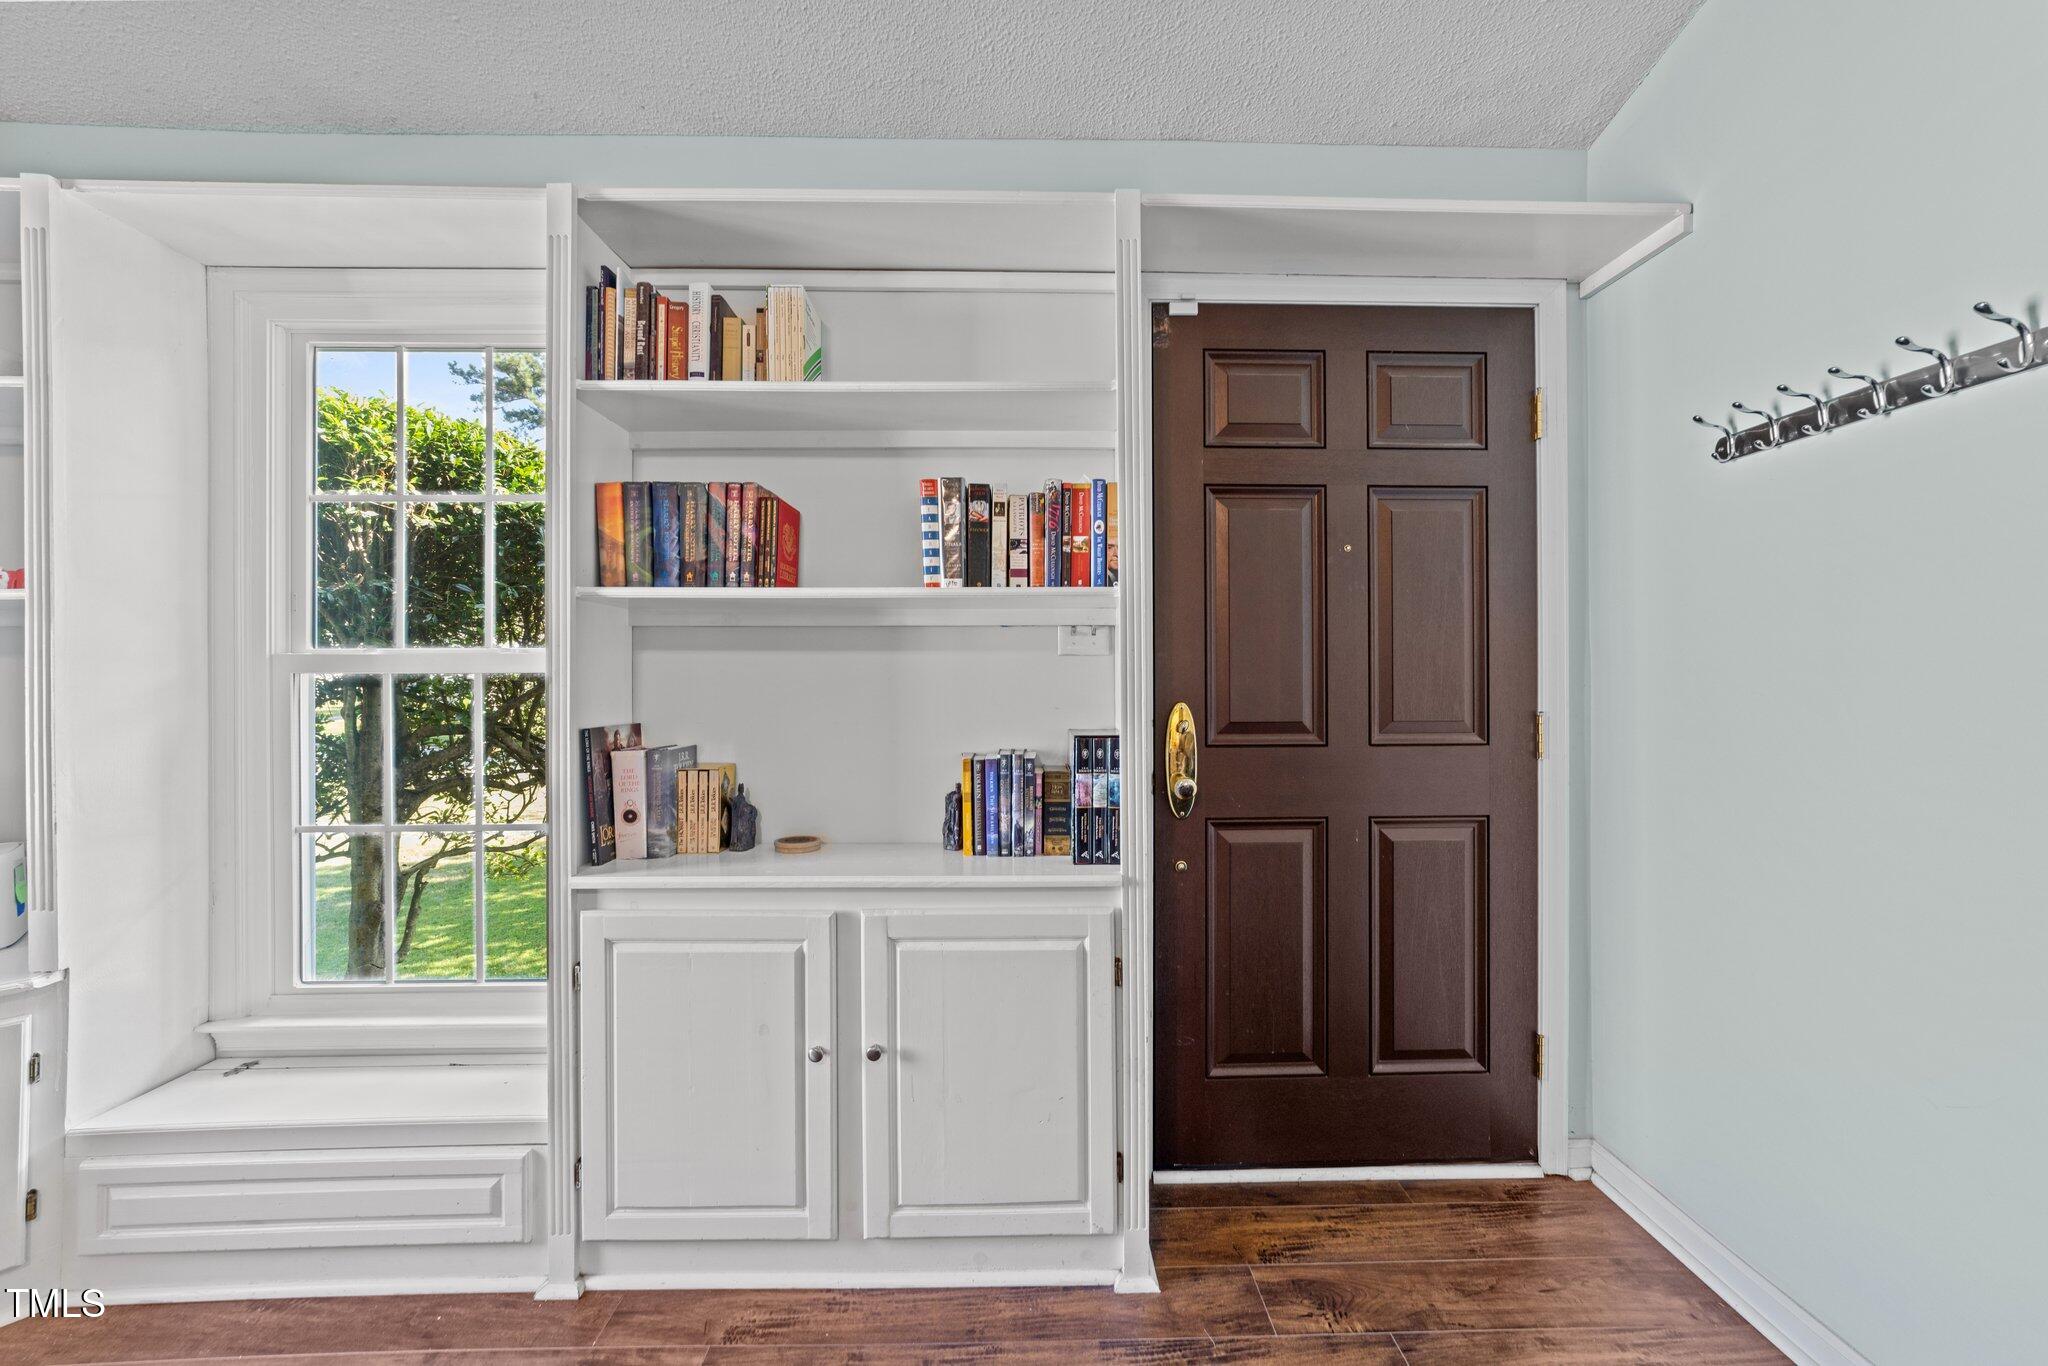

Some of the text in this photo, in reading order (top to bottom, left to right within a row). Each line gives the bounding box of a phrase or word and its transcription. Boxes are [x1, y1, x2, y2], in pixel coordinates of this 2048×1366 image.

[669, 325, 684, 379] Stupid History
[692, 291, 701, 362] HISTORY CHRISTIANITY
[1047, 502, 1061, 529] 1776
